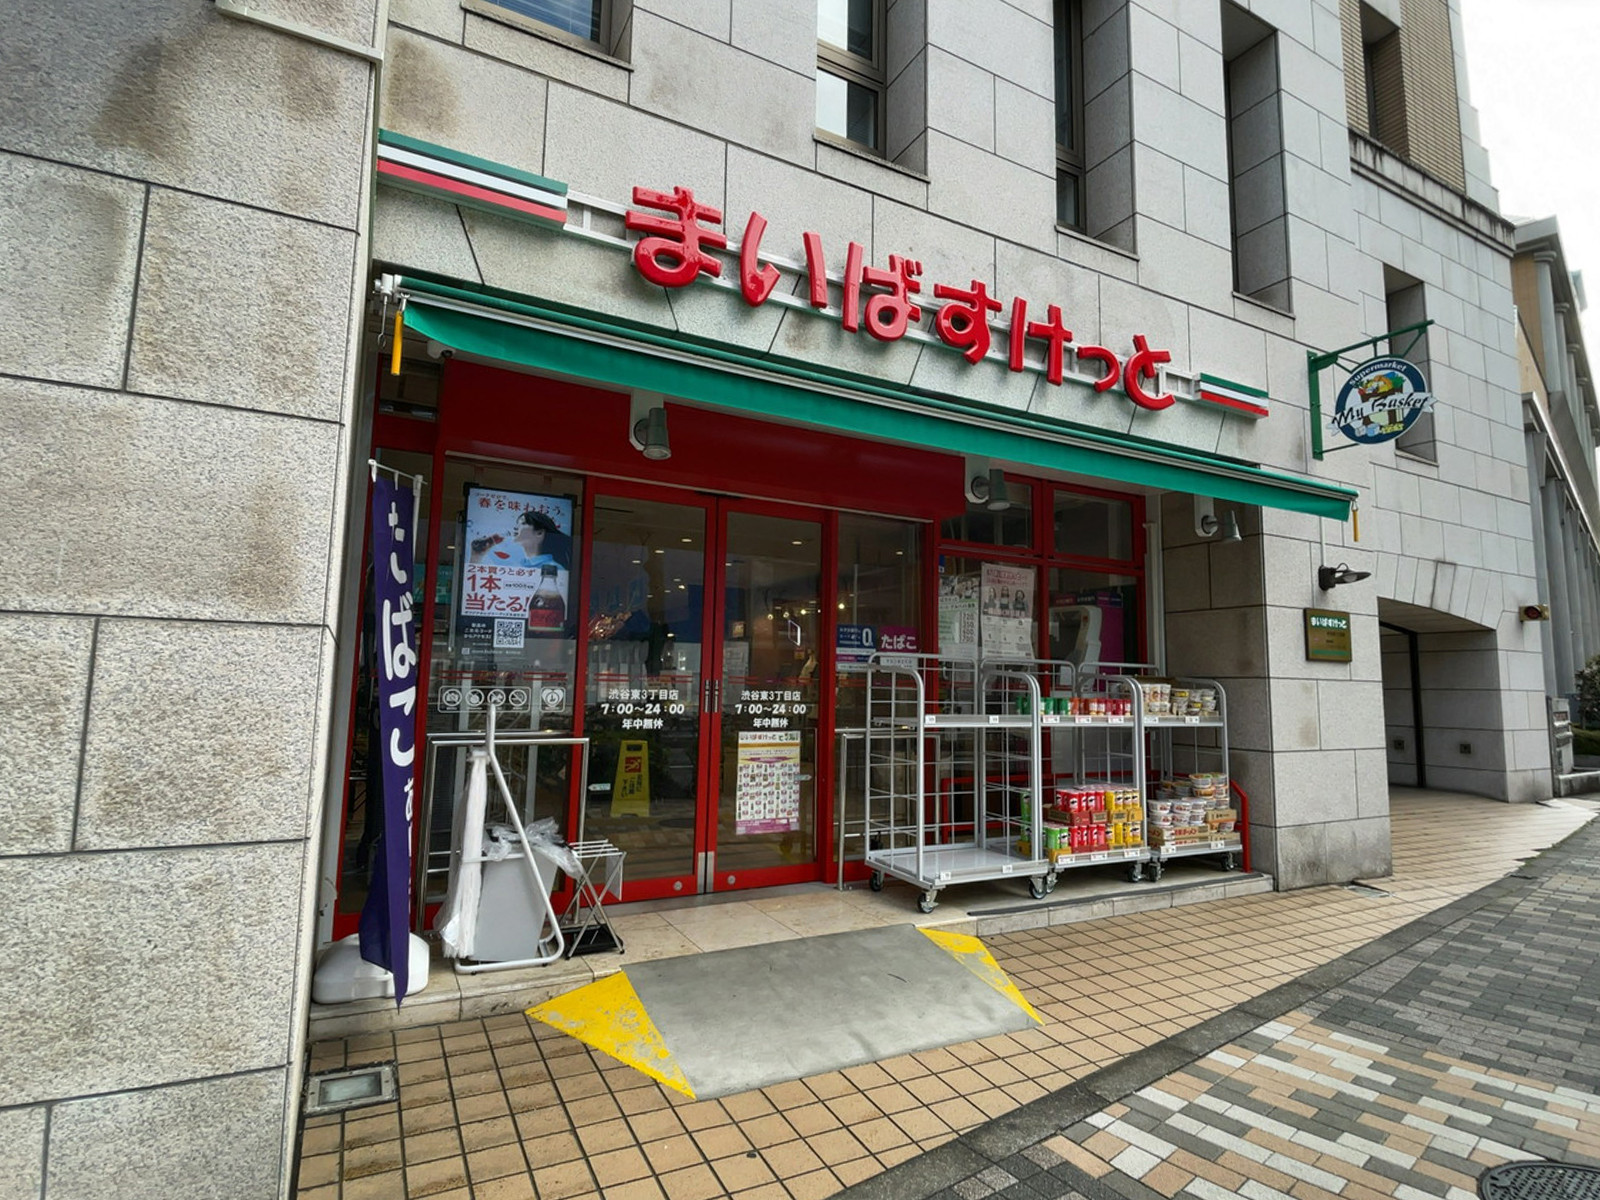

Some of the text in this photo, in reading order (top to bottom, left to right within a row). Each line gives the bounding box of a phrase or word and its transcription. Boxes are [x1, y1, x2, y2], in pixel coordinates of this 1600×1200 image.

[624, 185, 1176, 410] まいばすけっと
[1331, 392, 1431, 427] My Basket
[467, 564, 537, 577] 2本買うと必ず
[466, 574, 502, 593] 1本
[465, 592, 530, 612] 当たる!
[881, 634, 917, 650] たばこ
[608, 689, 680, 700] 渋谷東3丁目店
[741, 690, 802, 701] 渋谷東3丁目店
[622, 718, 664, 730] 年中無休
[753, 717, 789, 728] 年中無休
